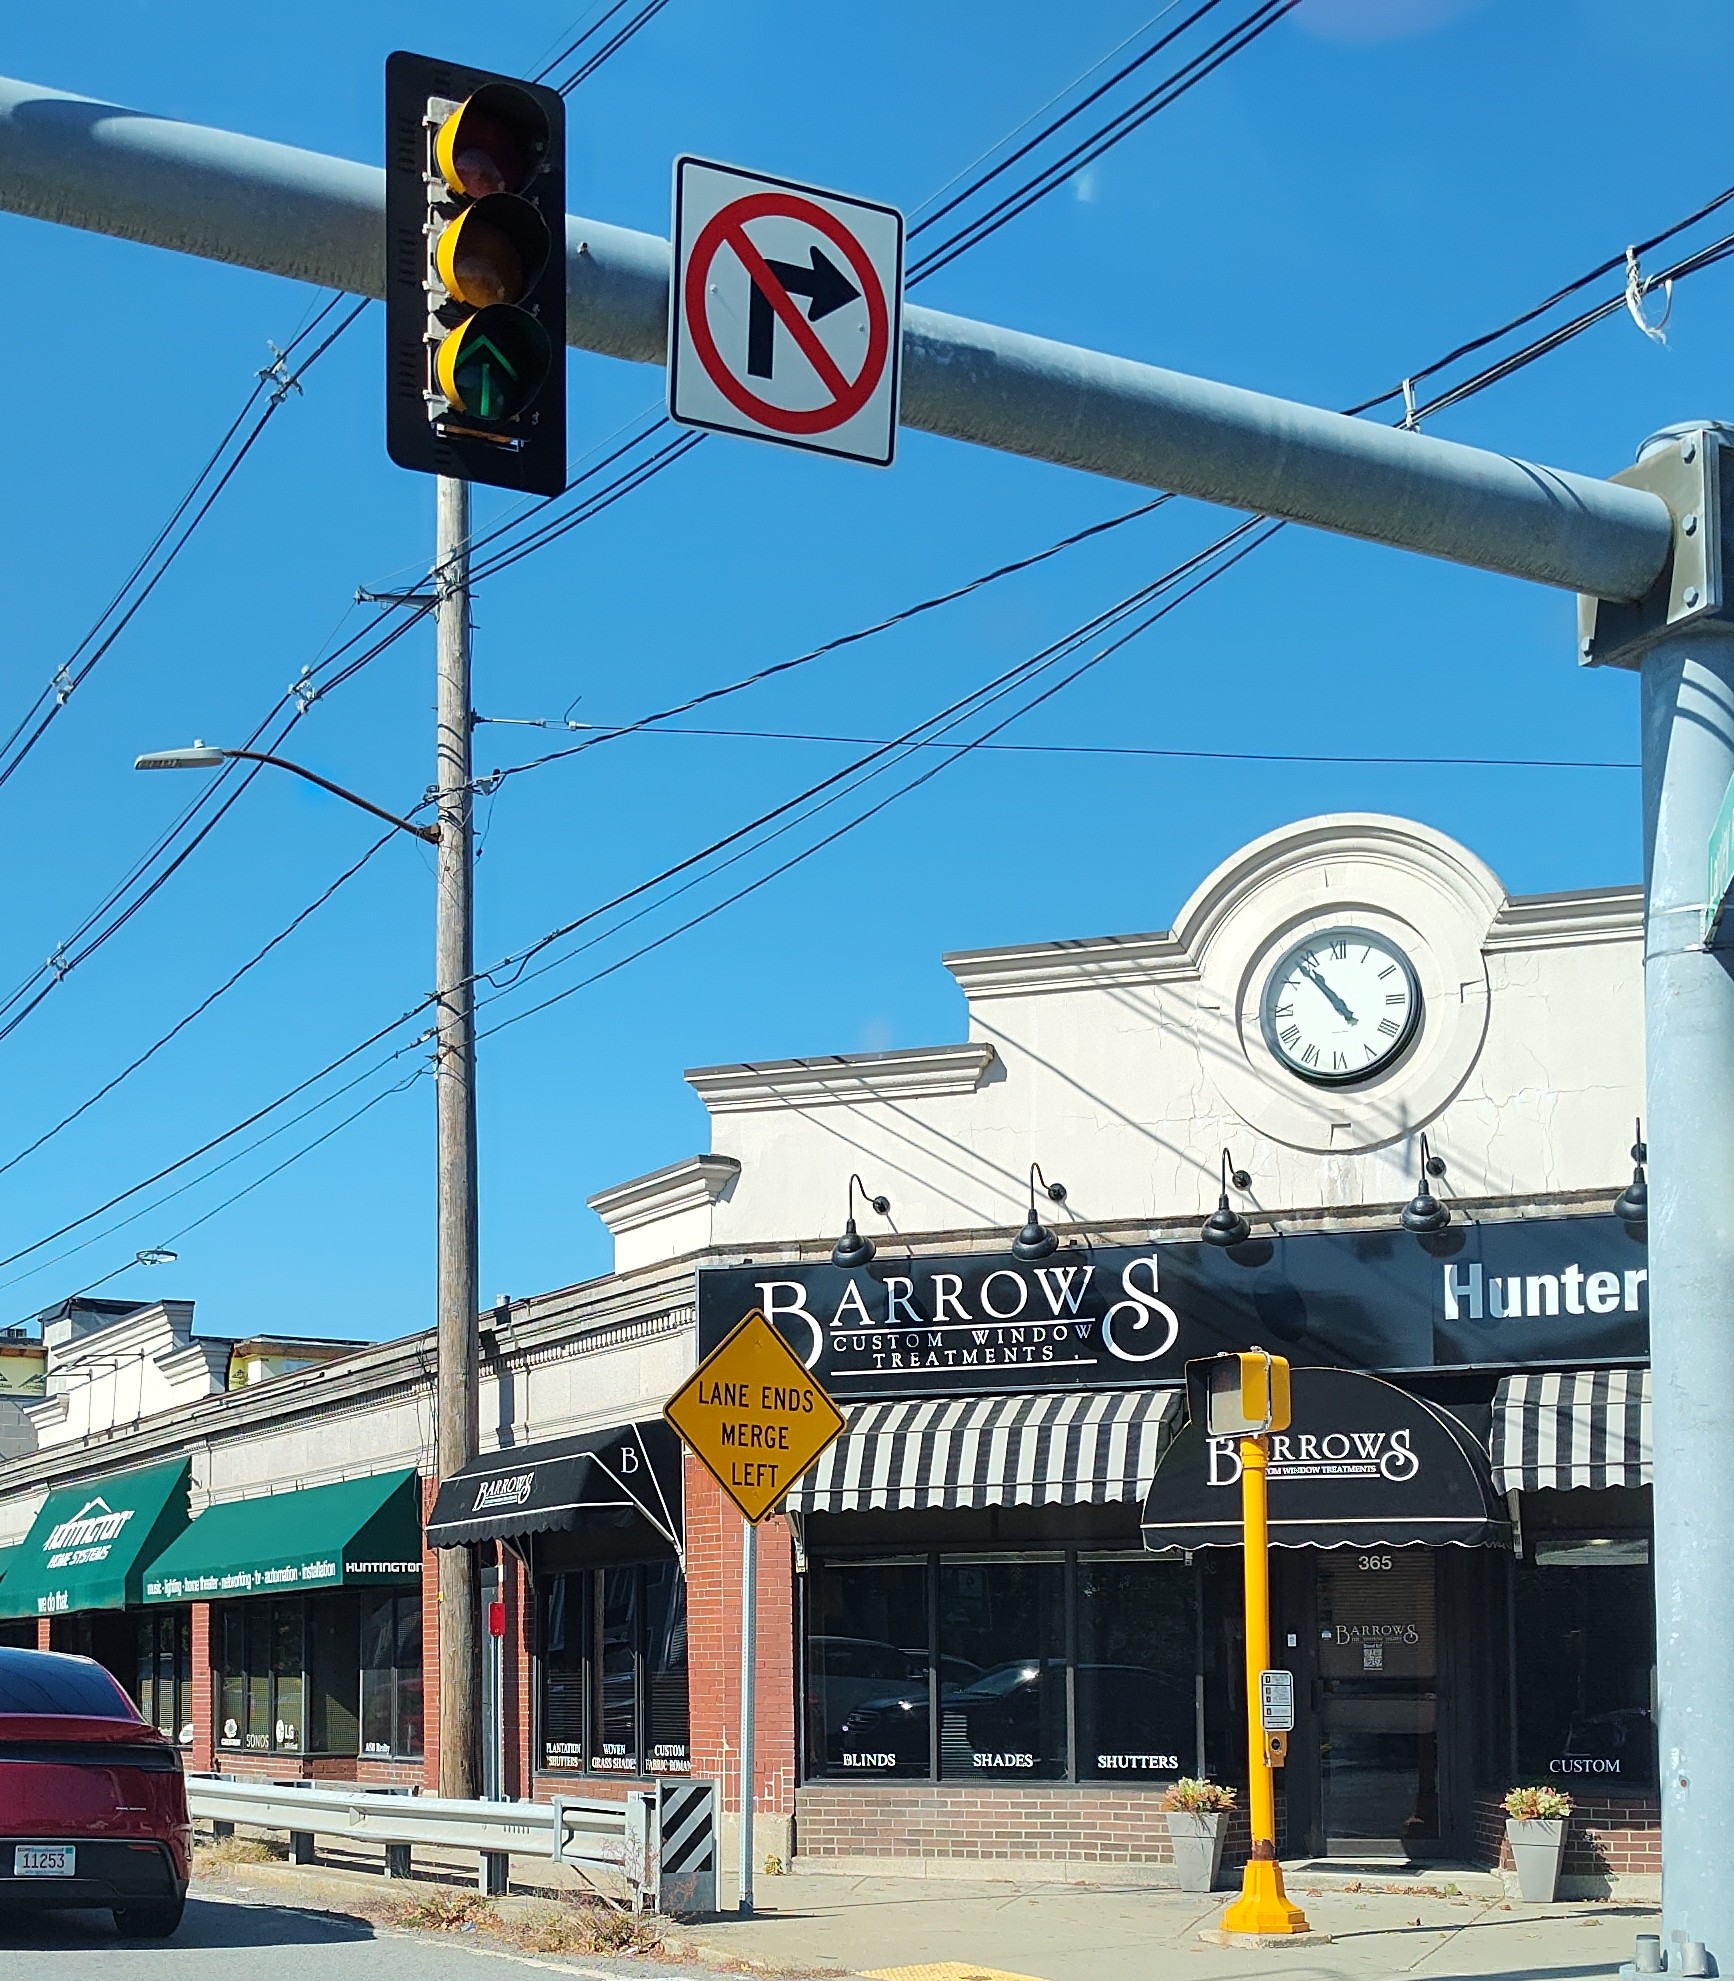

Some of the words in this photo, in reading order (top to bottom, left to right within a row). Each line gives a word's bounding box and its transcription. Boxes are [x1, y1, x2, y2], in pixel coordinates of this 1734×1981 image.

[1443, 1262, 1648, 1320] Hunter
[754, 1253, 1179, 1371] BARROWS
[833, 1332, 943, 1353] CUSTOM
[972, 1323, 1093, 1343] WINDOW
[872, 1344, 1055, 1370] TREATMENTS
[698, 1380, 749, 1408] LANE
[761, 1386, 814, 1413] ENDS
[721, 1422, 789, 1450] MERGE
[620, 1447, 639, 1473] B
[1205, 1428, 1420, 1486] BRROWS
[731, 1461, 779, 1488] LEFT
[1321, 1465, 1377, 1474] TREATMENTS
[472, 1471, 535, 1512] BARROWS
[1358, 1555, 1393, 1571] 365
[1336, 1624, 1419, 1645] BARROWS
[246, 1733, 270, 1748] SONOS
[654, 1744, 685, 1757] CUSTOM
[842, 1753, 896, 1767] BLINDS
[972, 1753, 1034, 1768] SHADES
[1097, 1755, 1179, 1770] SHUTTERS
[1549, 1759, 1622, 1774] CUSTOM
[23, 1853, 65, 1869] 11253
